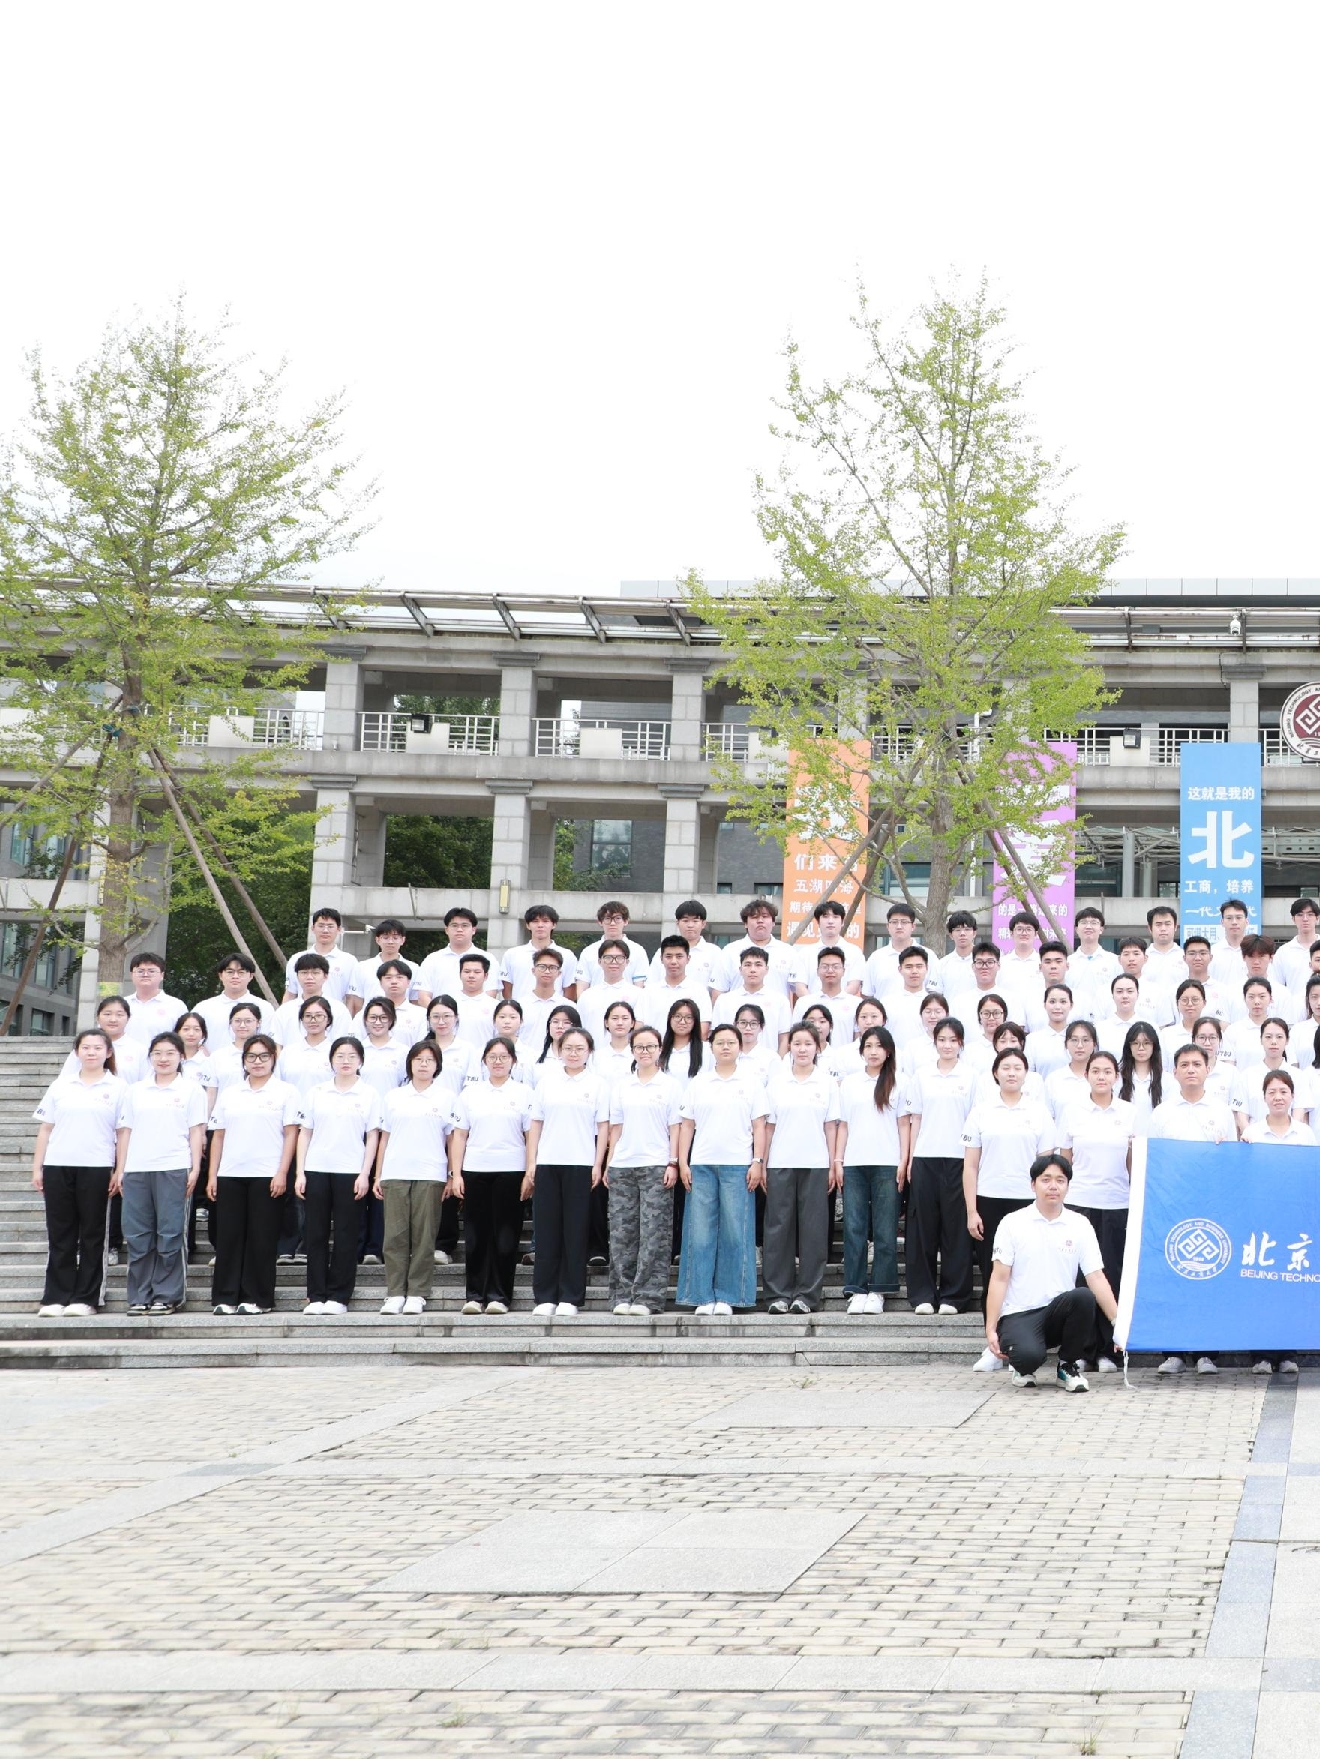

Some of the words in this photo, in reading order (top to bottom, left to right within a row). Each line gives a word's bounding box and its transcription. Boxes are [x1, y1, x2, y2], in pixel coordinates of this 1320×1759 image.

[1187, 786, 1255, 800] 这就是我的
[1187, 810, 1255, 869] 北
[1240, 1268, 1279, 1281] BEIJING
